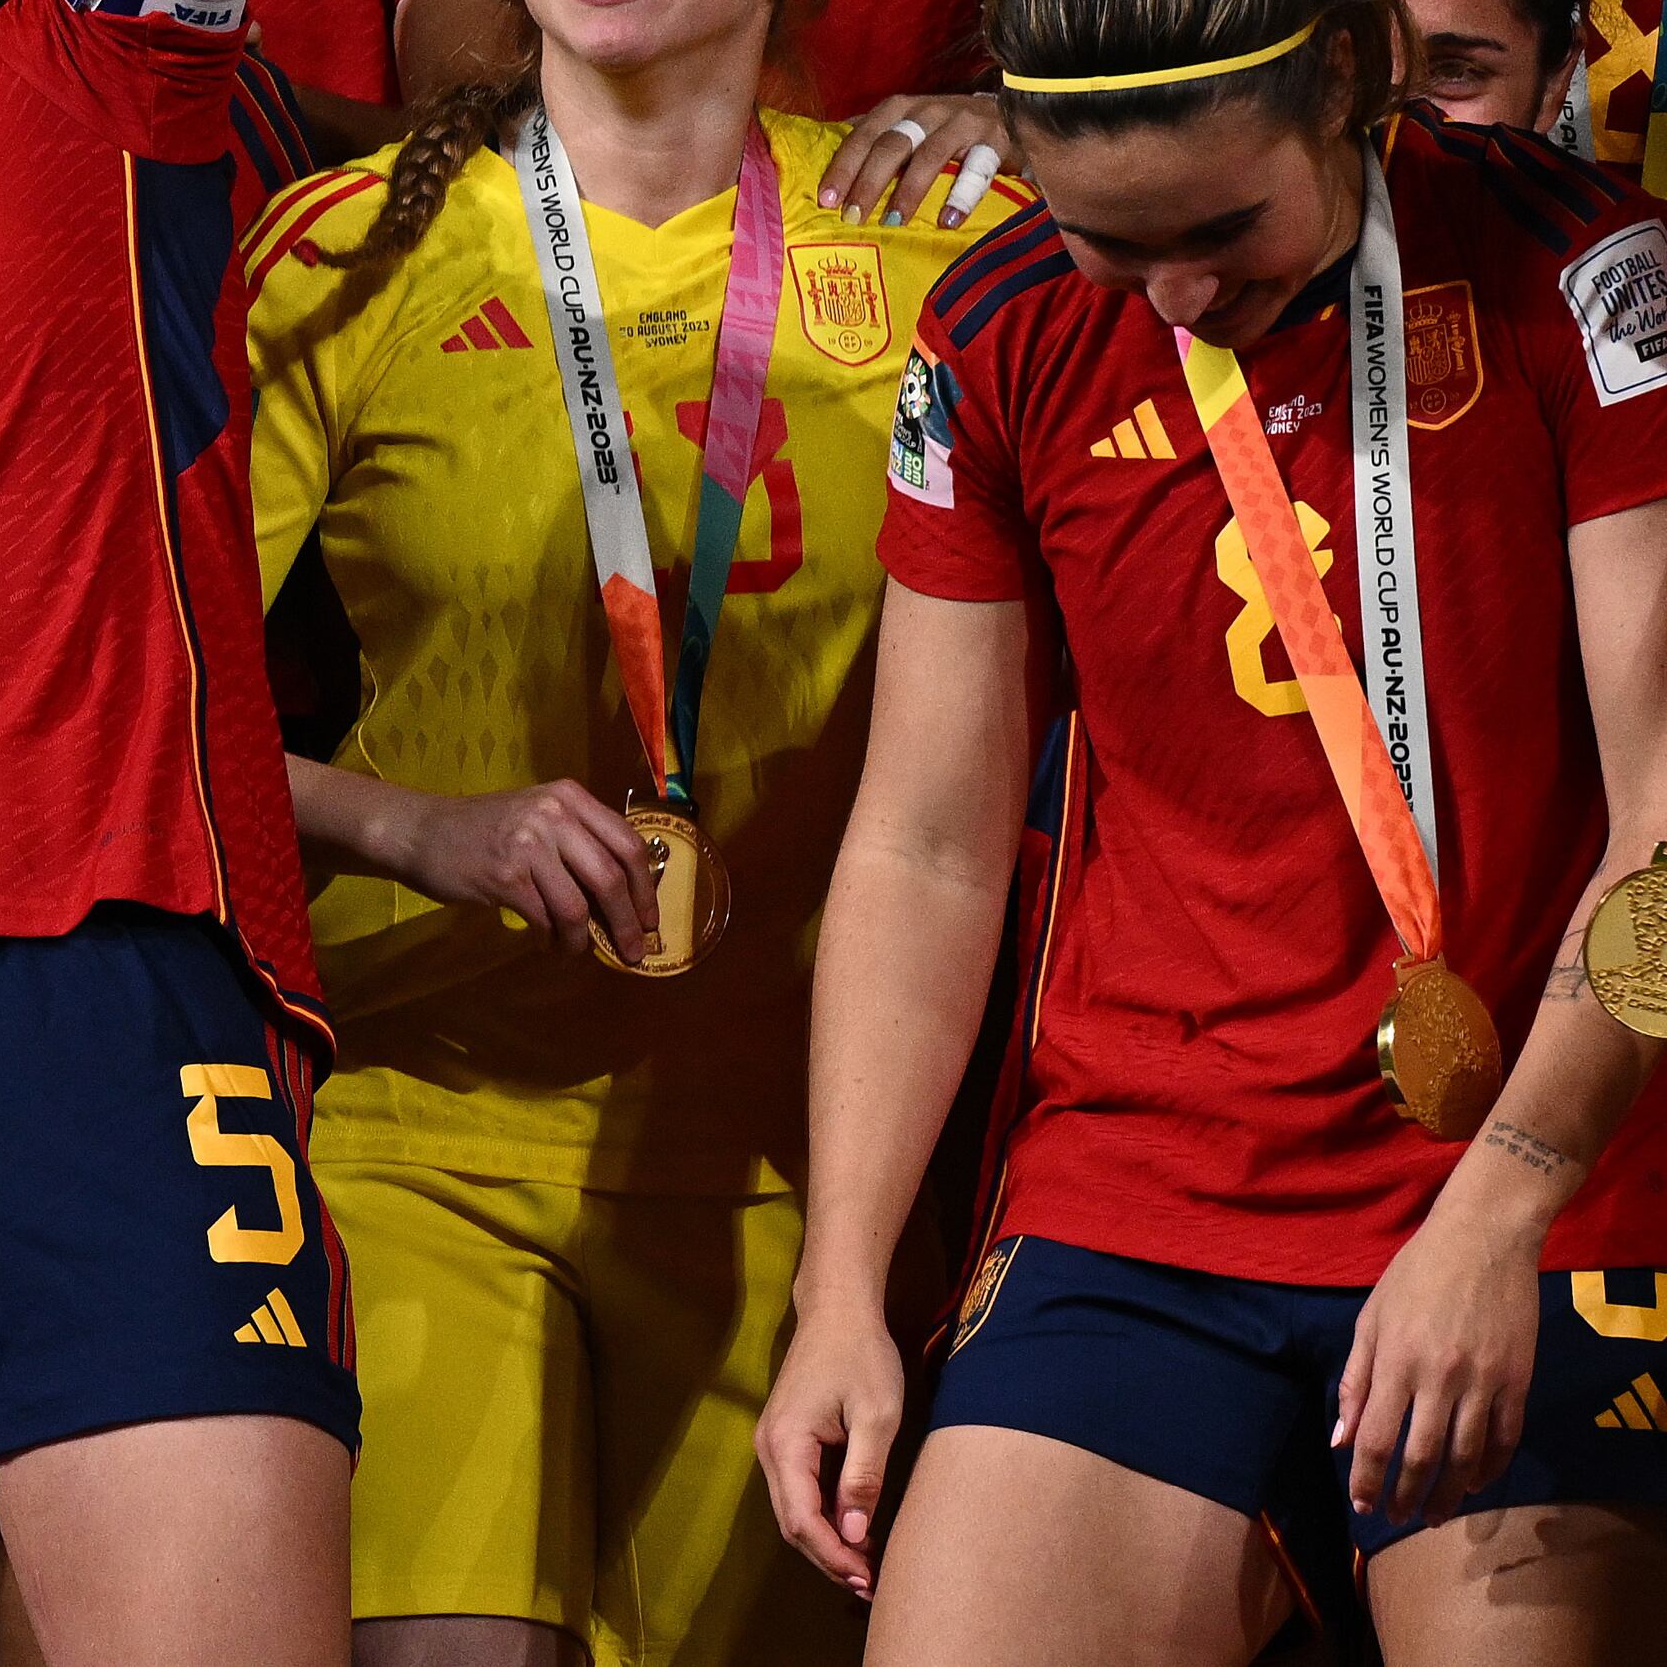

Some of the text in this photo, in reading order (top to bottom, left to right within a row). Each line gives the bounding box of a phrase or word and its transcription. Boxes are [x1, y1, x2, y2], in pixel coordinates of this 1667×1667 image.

[175, 3, 232, 26] FIFA
[530, 107, 557, 191] OMEN'S
[541, 192, 575, 271] WORLD
[1591, 249, 1663, 294] FOOTBALL
[1601, 269, 1667, 317] UNITES
[560, 276, 586, 324] CUP
[639, 310, 687, 323] ENGLAND
[1364, 284, 1384, 340] FIFA
[1606, 305, 1667, 343] the Wor
[638, 324, 677, 337] AUGUST
[683, 320, 710, 333] 2023
[645, 334, 688, 348] SYDNEY
[1297, 403, 1322, 419] 2023
[1367, 341, 1390, 467] WOMEN'S
[1372, 471, 1395, 566] WORLD
[1215, 500, 1343, 718] 8
[1377, 571, 1399, 623] CUP
[179, 1063, 305, 1266] 5
